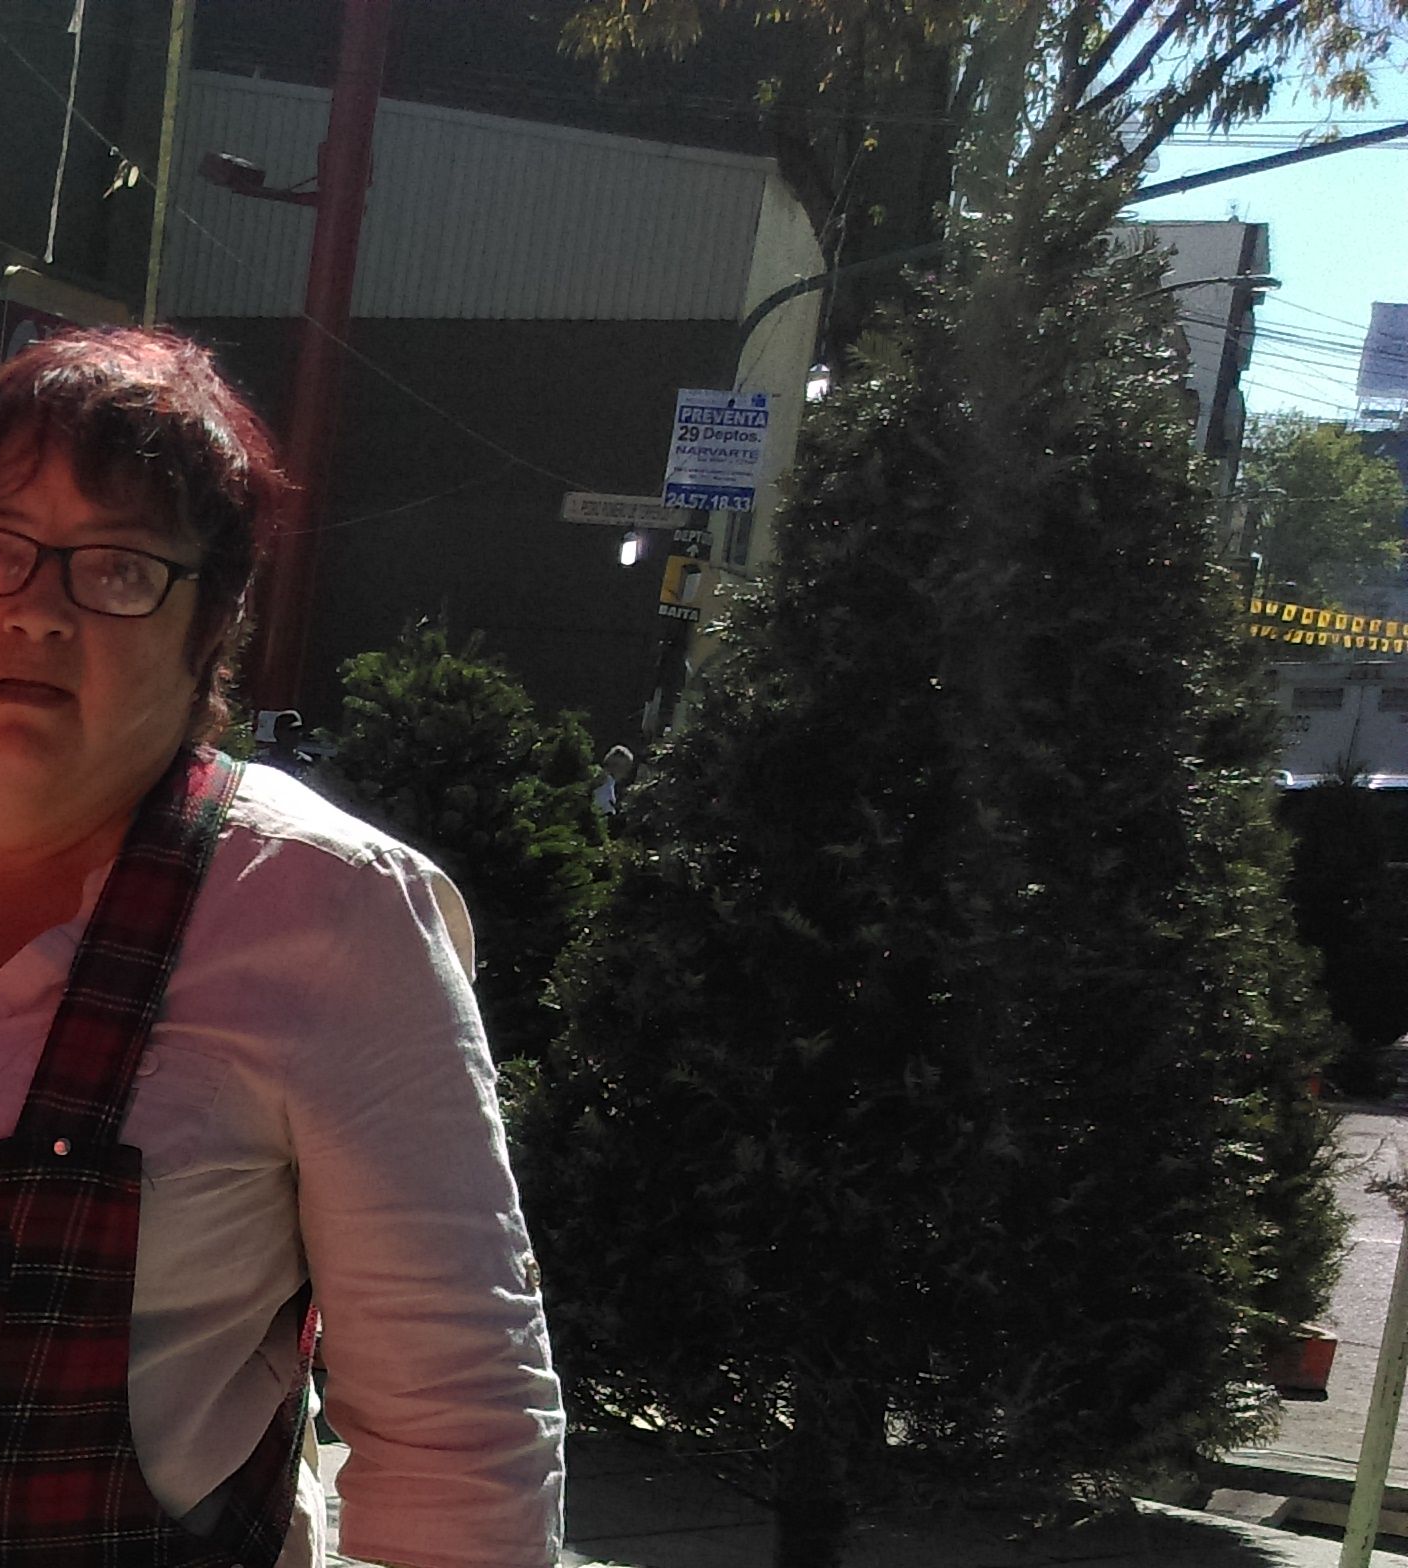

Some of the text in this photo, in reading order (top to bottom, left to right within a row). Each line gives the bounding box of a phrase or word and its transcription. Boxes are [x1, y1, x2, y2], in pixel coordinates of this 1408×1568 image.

[680, 407, 766, 427] PREVENTA
[678, 425, 761, 443] 29 Deptos.
[675, 445, 758, 460] NARVARTE
